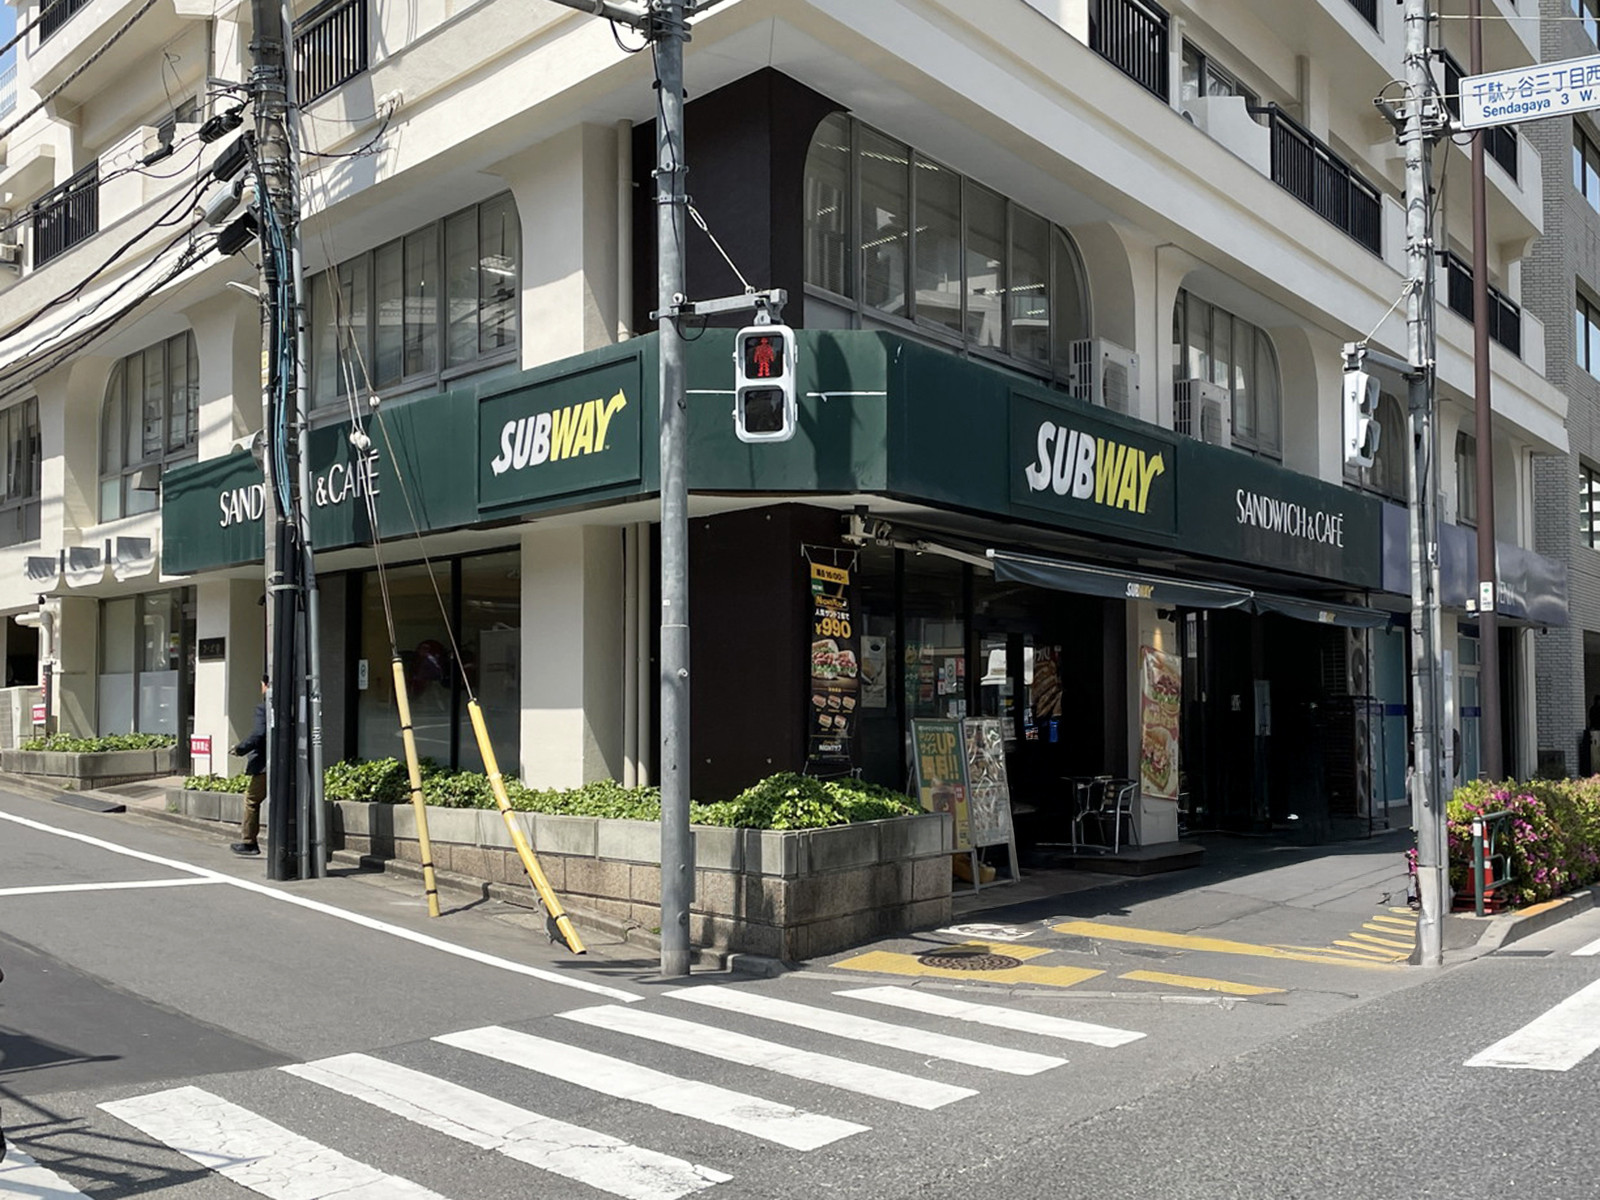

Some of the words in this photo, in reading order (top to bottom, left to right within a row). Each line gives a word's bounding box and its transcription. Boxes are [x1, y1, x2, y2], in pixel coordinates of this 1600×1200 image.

[1483, 99, 1551, 119] Sendagaya
[1560, 93, 1570, 106] 3
[491, 388, 628, 477] SUBWAY
[1024, 420, 1165, 514] SUBWAY
[815, 617, 852, 639] ¥990
[935, 732, 956, 755] UP
